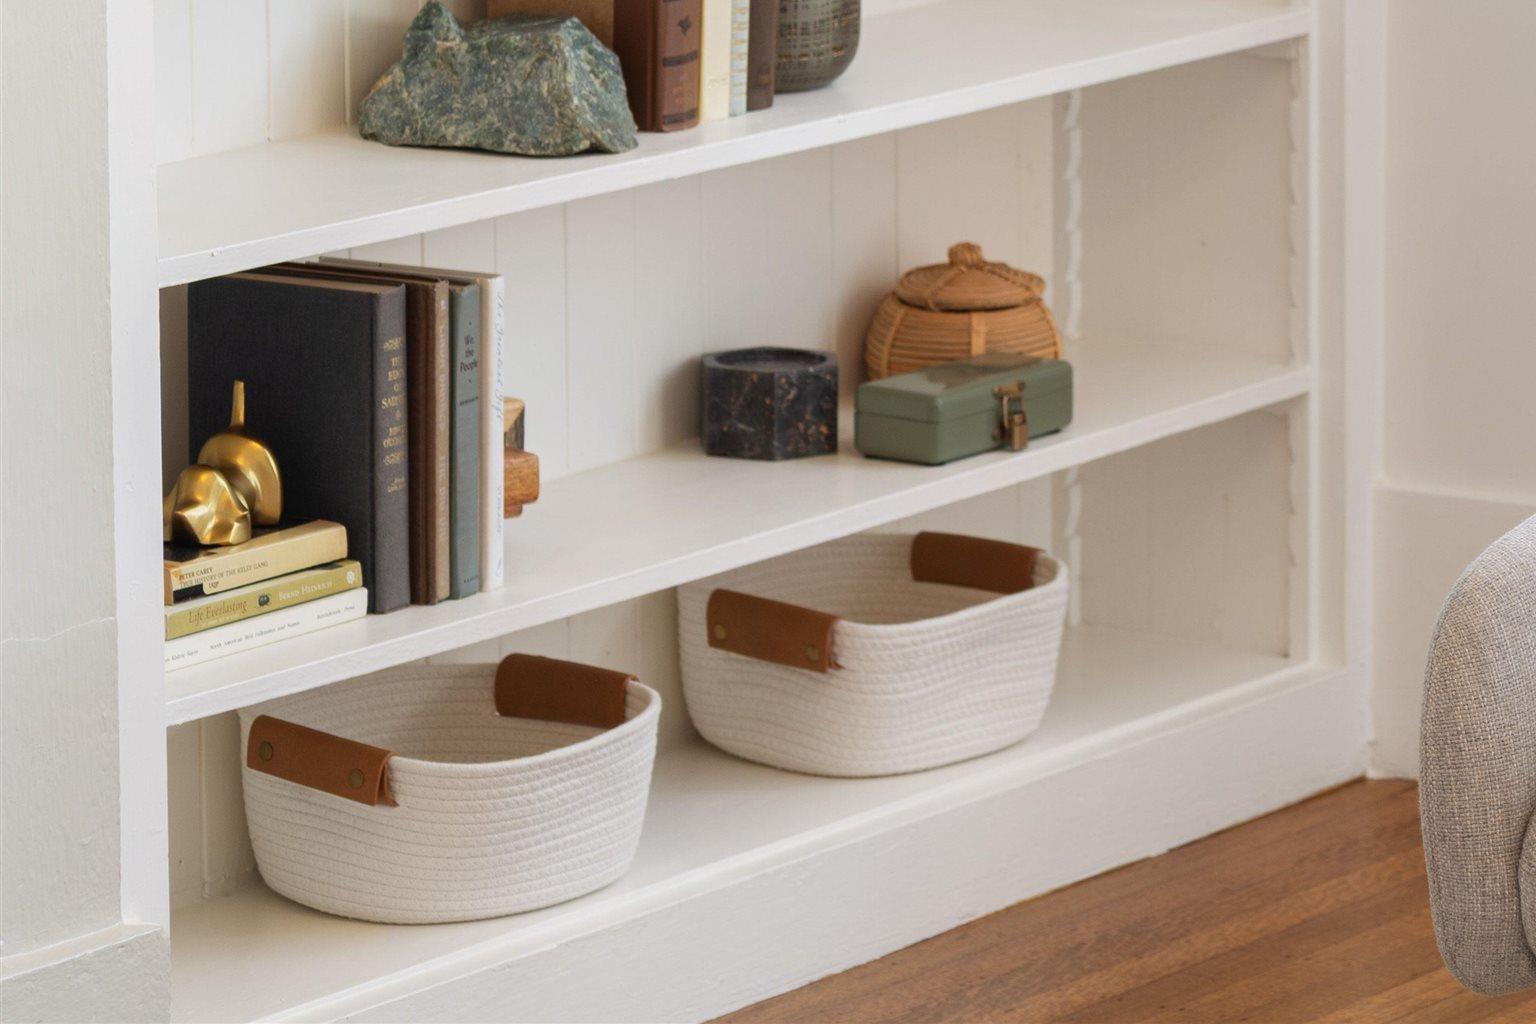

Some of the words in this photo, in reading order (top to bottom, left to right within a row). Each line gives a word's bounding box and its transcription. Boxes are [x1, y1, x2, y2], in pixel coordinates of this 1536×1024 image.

[464, 335, 475, 344] We
[465, 347, 474, 358] the
[460, 359, 478, 372] People
[178, 572, 195, 580] PETER
[196, 567, 213, 576] CAREY
[194, 574, 217, 586] HISTORY
[226, 568, 236, 577] THE
[237, 564, 252, 574] KELLY
[253, 560, 269, 570] GANG
[188, 609, 203, 626] Life
[206, 600, 248, 619] Everlasting
